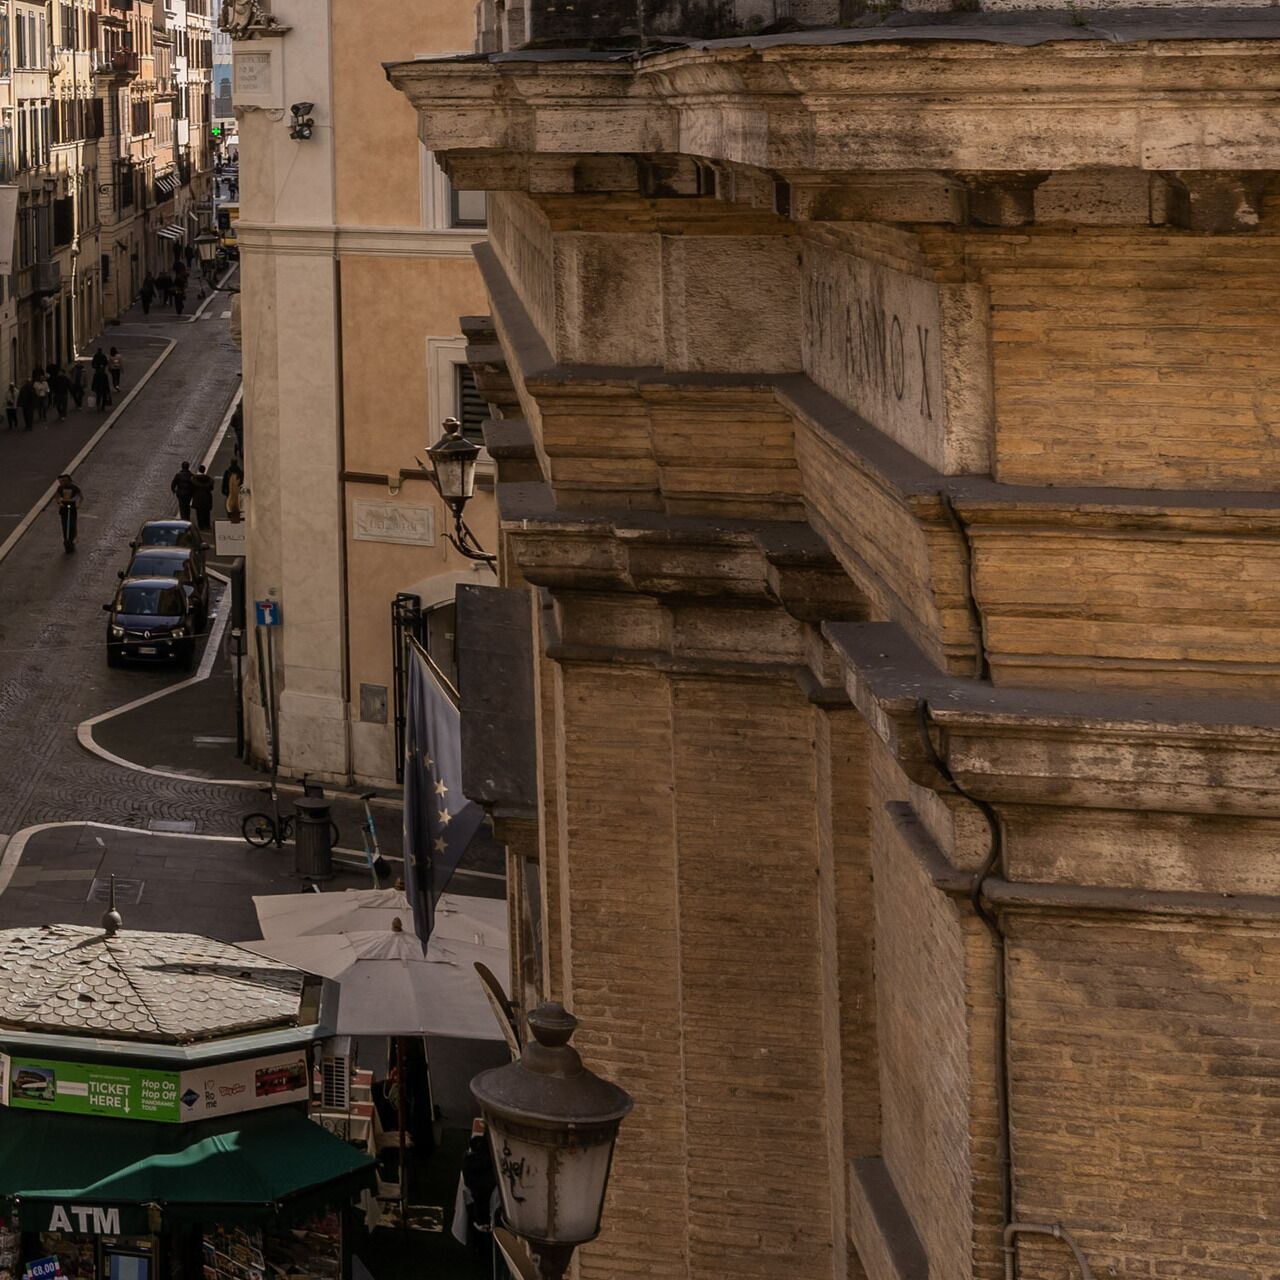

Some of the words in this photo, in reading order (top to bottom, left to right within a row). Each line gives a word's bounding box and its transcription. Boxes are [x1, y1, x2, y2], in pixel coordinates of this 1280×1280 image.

[844, 293, 905, 412] ANNO
[916, 323, 933, 421] X
[89, 1081, 131, 1096] TICKET
[141, 1079, 159, 1091] Hop
[161, 1080, 175, 1090] On
[89, 1095, 121, 1108] HERE
[141, 1089, 159, 1100] Hop
[161, 1089, 177, 1100] Off
[48, 1205, 121, 1235] ATM
[32, 1261, 55, 1277] €8,00
